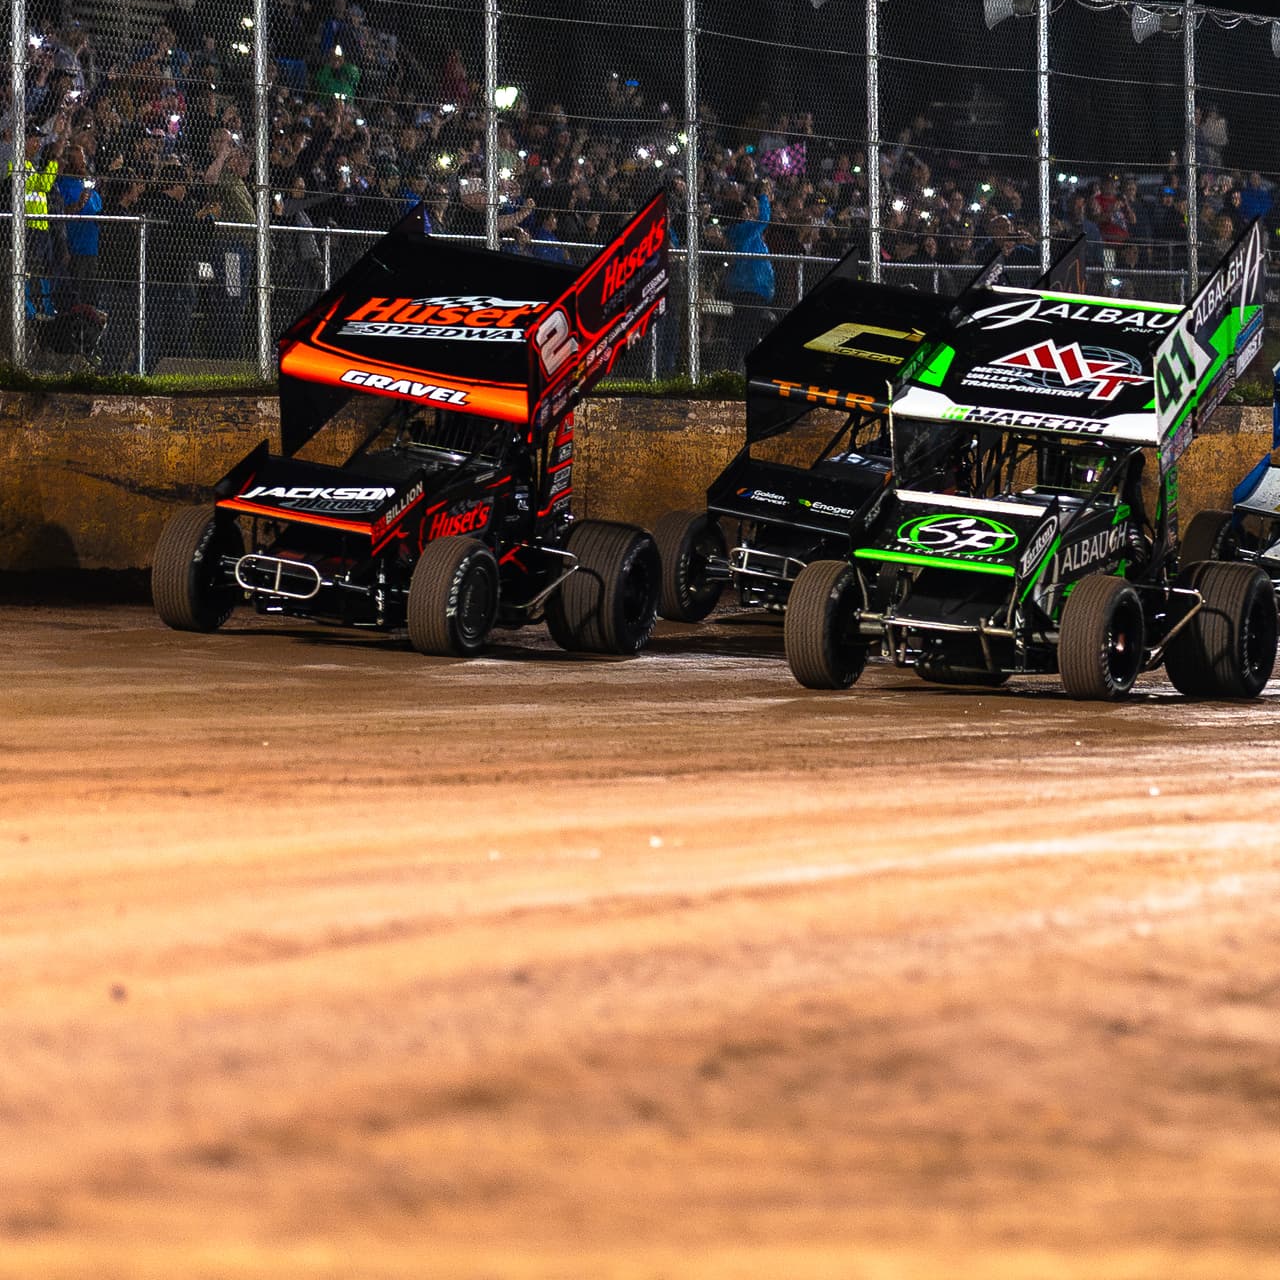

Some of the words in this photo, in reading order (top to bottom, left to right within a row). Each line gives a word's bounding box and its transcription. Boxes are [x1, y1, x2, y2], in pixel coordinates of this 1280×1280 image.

[1194, 252, 1245, 334] ALBAUGH
[535, 310, 579, 376] 2
[966, 373, 1020, 383] VALLEY
[971, 367, 1034, 379] MESILLA
[1156, 329, 1196, 415] 41
[341, 370, 470, 405] GRAVEL
[960, 379, 1084, 398] TRANSPORTATION
[385, 480, 424, 525] BILLION
[750, 494, 787, 506] Harvest
[753, 489, 785, 500] Golden
[812, 502, 855, 515] Enogen
[1061, 521, 1127, 575] ALBAUGH
